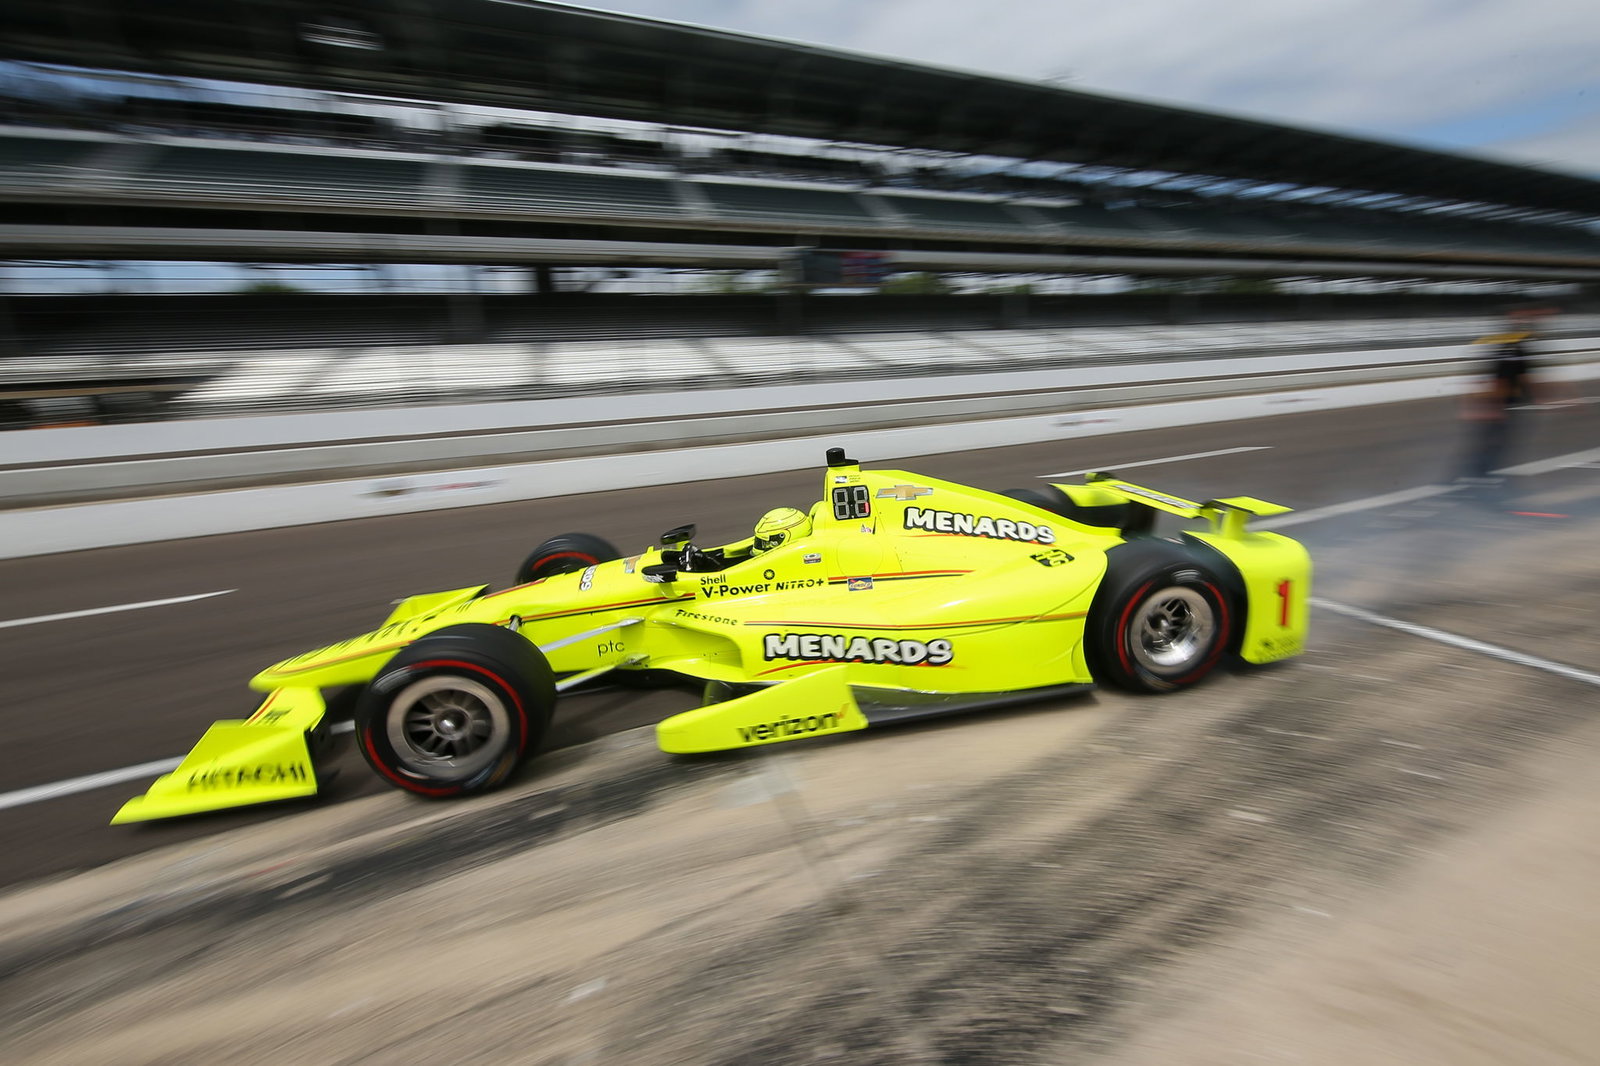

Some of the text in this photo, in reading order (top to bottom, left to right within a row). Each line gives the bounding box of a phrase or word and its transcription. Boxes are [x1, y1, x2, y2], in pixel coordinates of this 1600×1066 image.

[904, 507, 1056, 545] MENARDS
[700, 574, 726, 585] Shell
[702, 583, 771, 598] V-Power
[1274, 578, 1294, 630] 1
[675, 609, 738, 625] Firestone
[597, 640, 625, 657] ptc
[764, 634, 954, 666] MENARDS
[737, 712, 839, 742] verizon
